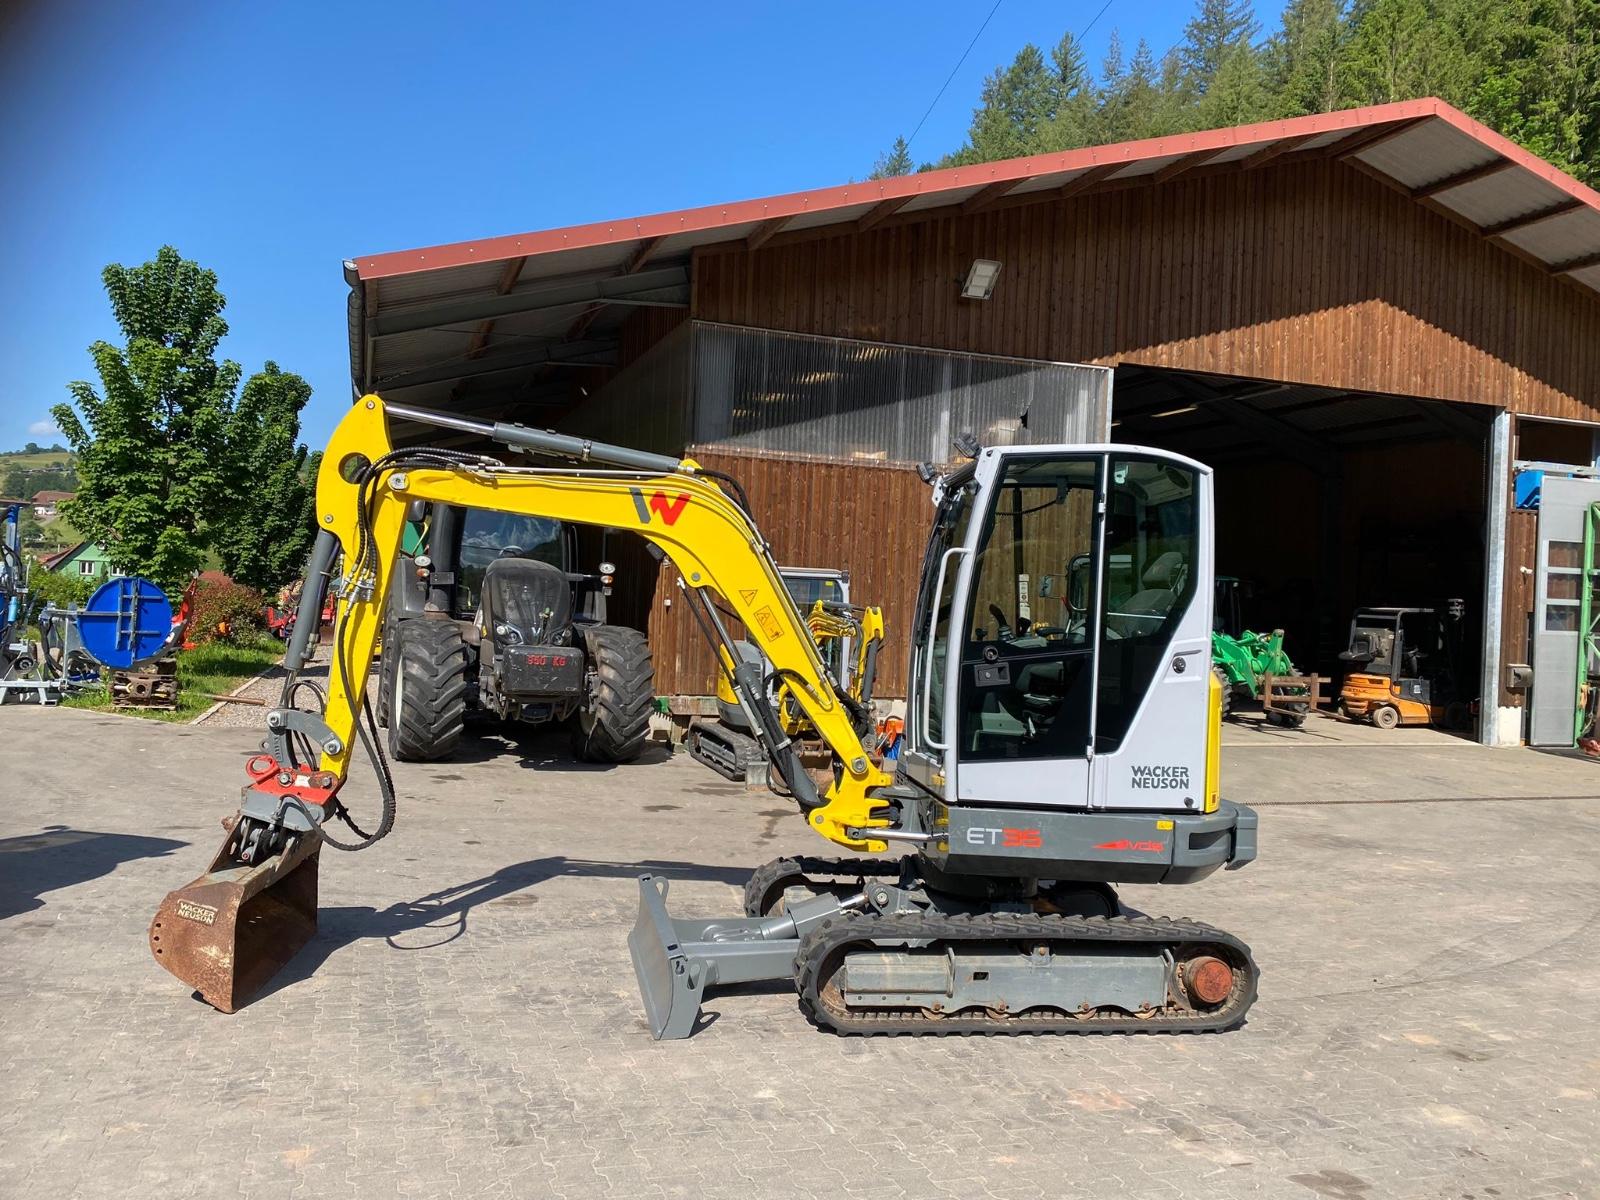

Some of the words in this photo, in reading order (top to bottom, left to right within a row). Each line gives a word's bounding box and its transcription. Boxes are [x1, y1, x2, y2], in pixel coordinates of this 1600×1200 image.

[1131, 766, 1189, 778] WACKER
[1131, 777, 1190, 789] NEUSON
[180, 902, 215, 916] WACKER
[177, 909, 214, 924] NEUSON
